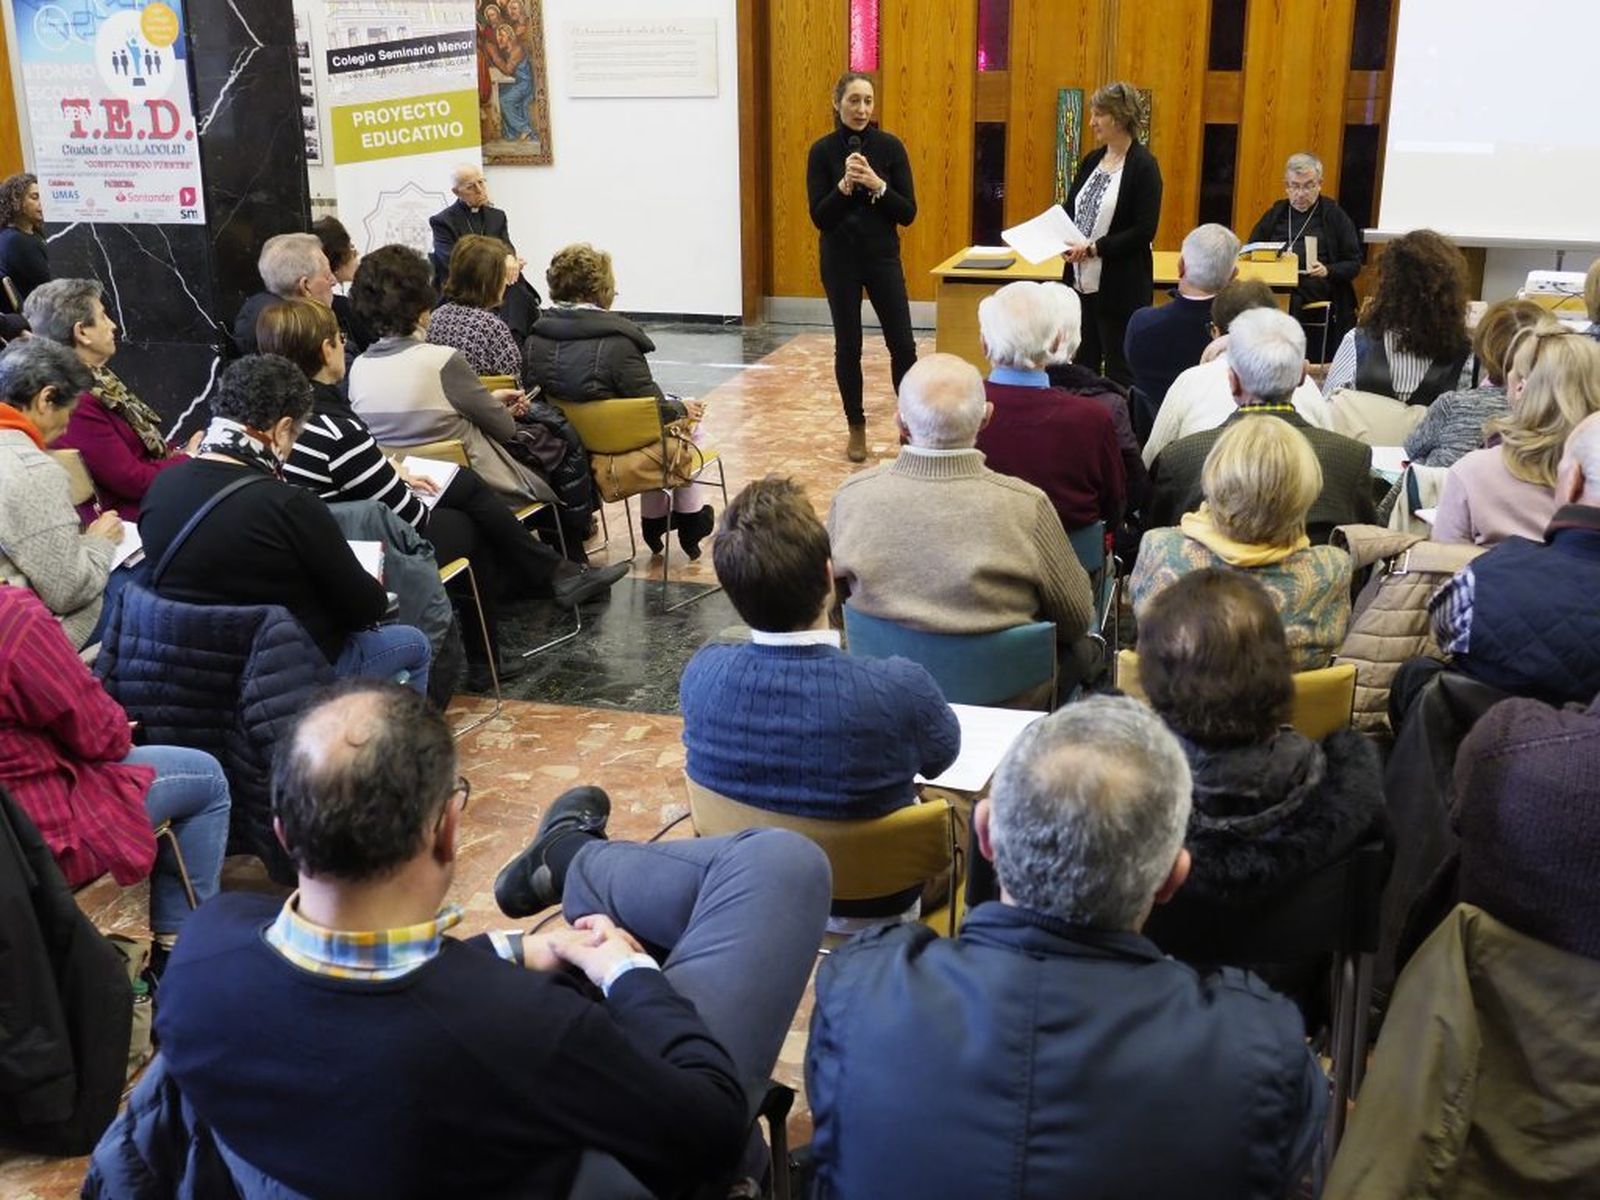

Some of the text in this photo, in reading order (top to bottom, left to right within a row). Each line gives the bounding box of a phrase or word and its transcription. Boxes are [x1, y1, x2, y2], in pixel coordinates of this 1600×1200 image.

[332, 39, 473, 67] Colegio Seminario Menor
[61, 98, 194, 141] T.E.D.
[352, 100, 451, 127] PROYECTO
[361, 121, 464, 148] EDUCATIVO
[62, 144, 186, 156] Ciudad de VALLADOLID
[52, 191, 80, 199] UMAS
[127, 192, 175, 202] Santander
[180, 209, 198, 219] sm
